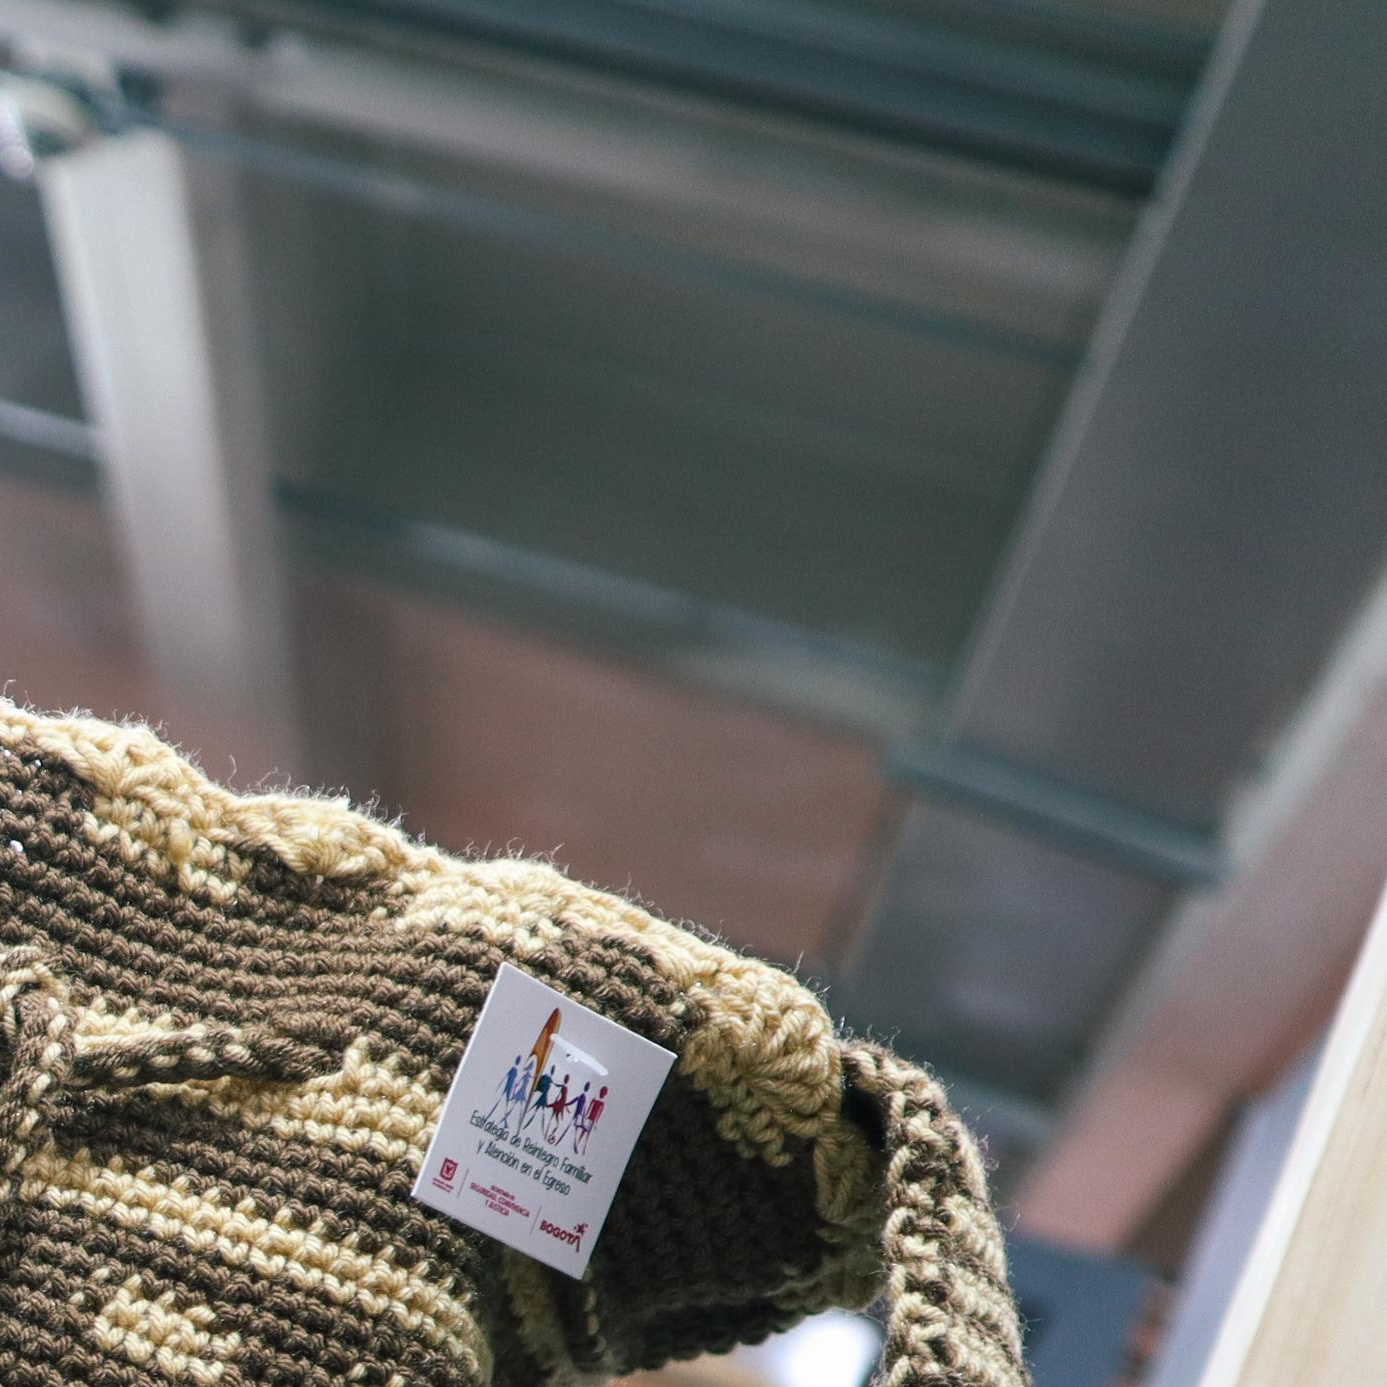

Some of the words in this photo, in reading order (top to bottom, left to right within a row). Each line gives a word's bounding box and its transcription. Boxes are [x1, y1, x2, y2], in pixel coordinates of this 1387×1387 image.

[476, 1139, 485, 1154] y
[520, 1162, 533, 1176] en
[533, 1165, 545, 1180] el
[542, 1170, 571, 1196] Egreso
[510, 1135, 522, 1148] de
[522, 1137, 560, 1167] Reintegro
